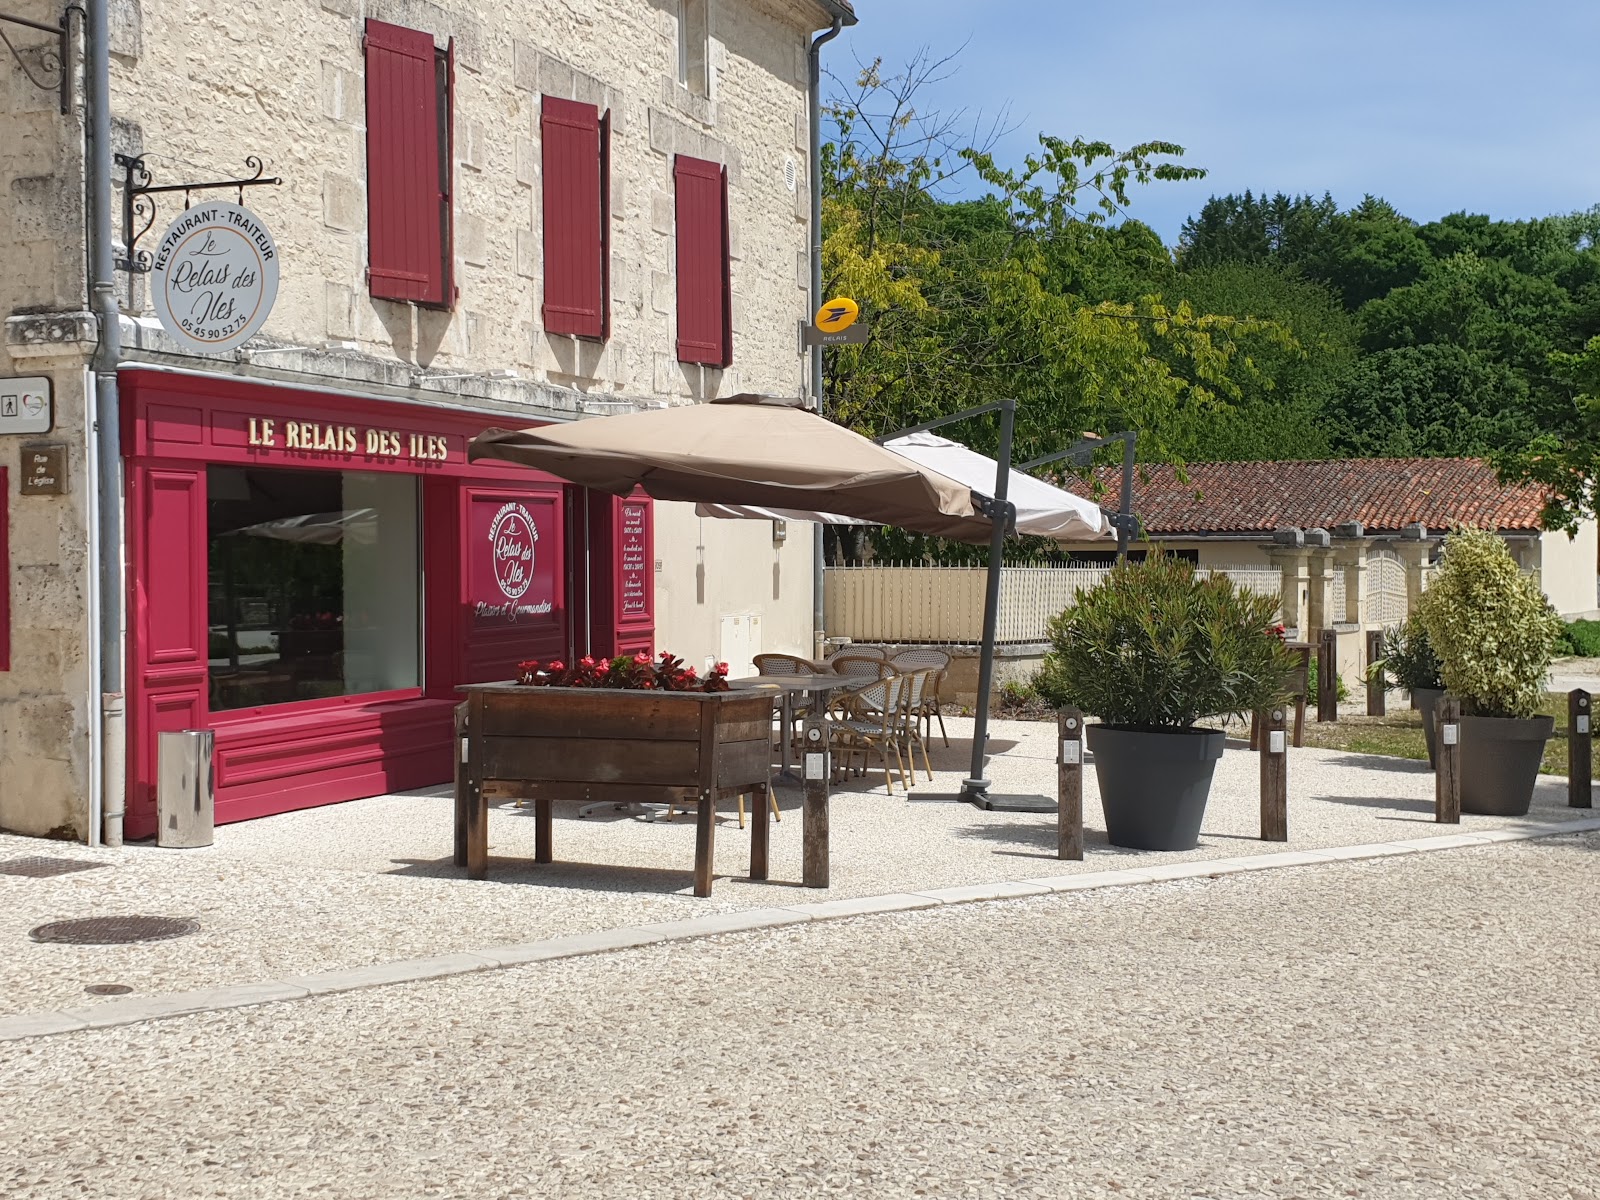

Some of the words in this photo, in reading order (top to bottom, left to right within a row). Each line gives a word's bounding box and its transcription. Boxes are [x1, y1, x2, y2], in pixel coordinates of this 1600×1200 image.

[155, 209, 218, 271] RESTAURANT
[228, 210, 274, 261] TRAITEUR
[189, 230, 231, 256] Le
[171, 260, 231, 293] Relais
[232, 266, 256, 289] des
[190, 290, 237, 325] Iles
[181, 318, 194, 332] 05
[193, 326, 206, 338] 45
[207, 329, 220, 339] 90
[222, 324, 235, 337] 52
[234, 314, 247, 328] 75
[248, 417, 275, 446] LE
[285, 421, 357, 453] RELAIS
[365, 428, 401, 456] DES
[408, 433, 448, 461] ILES
[34, 454, 48, 463] Rue
[36, 465, 46, 474] de
[488, 502, 516, 541] RESTAURANT
[519, 504, 539, 542] TRAITEUR
[504, 516, 522, 536] Le
[496, 536, 522, 560] Relais
[521, 545, 532, 560] des
